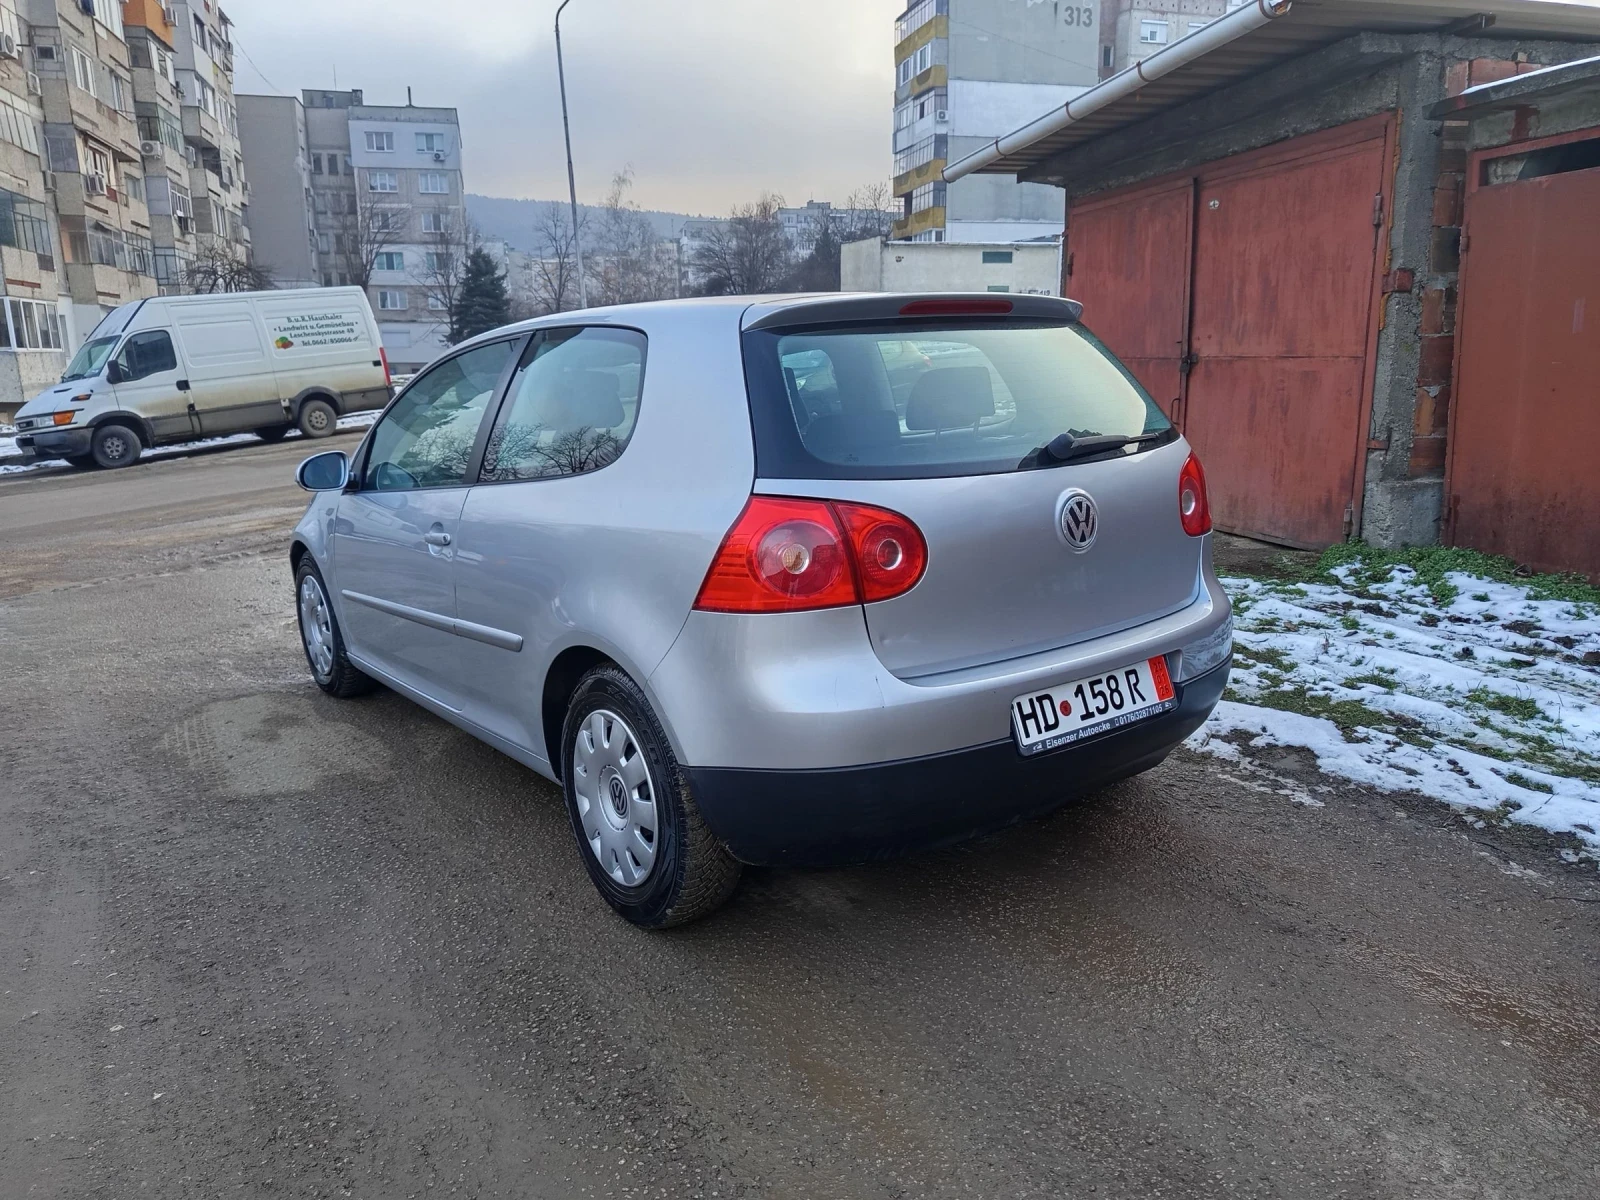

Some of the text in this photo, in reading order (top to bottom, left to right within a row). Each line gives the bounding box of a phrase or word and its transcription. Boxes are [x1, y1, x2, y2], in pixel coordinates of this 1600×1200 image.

[1064, 6, 1092, 28] 313
[1062, 496, 1098, 549] VW
[1156, 673, 1166, 684] 01
[1017, 668, 1146, 738] HD 158 R
[1078, 722, 1111, 739] Autoecke
